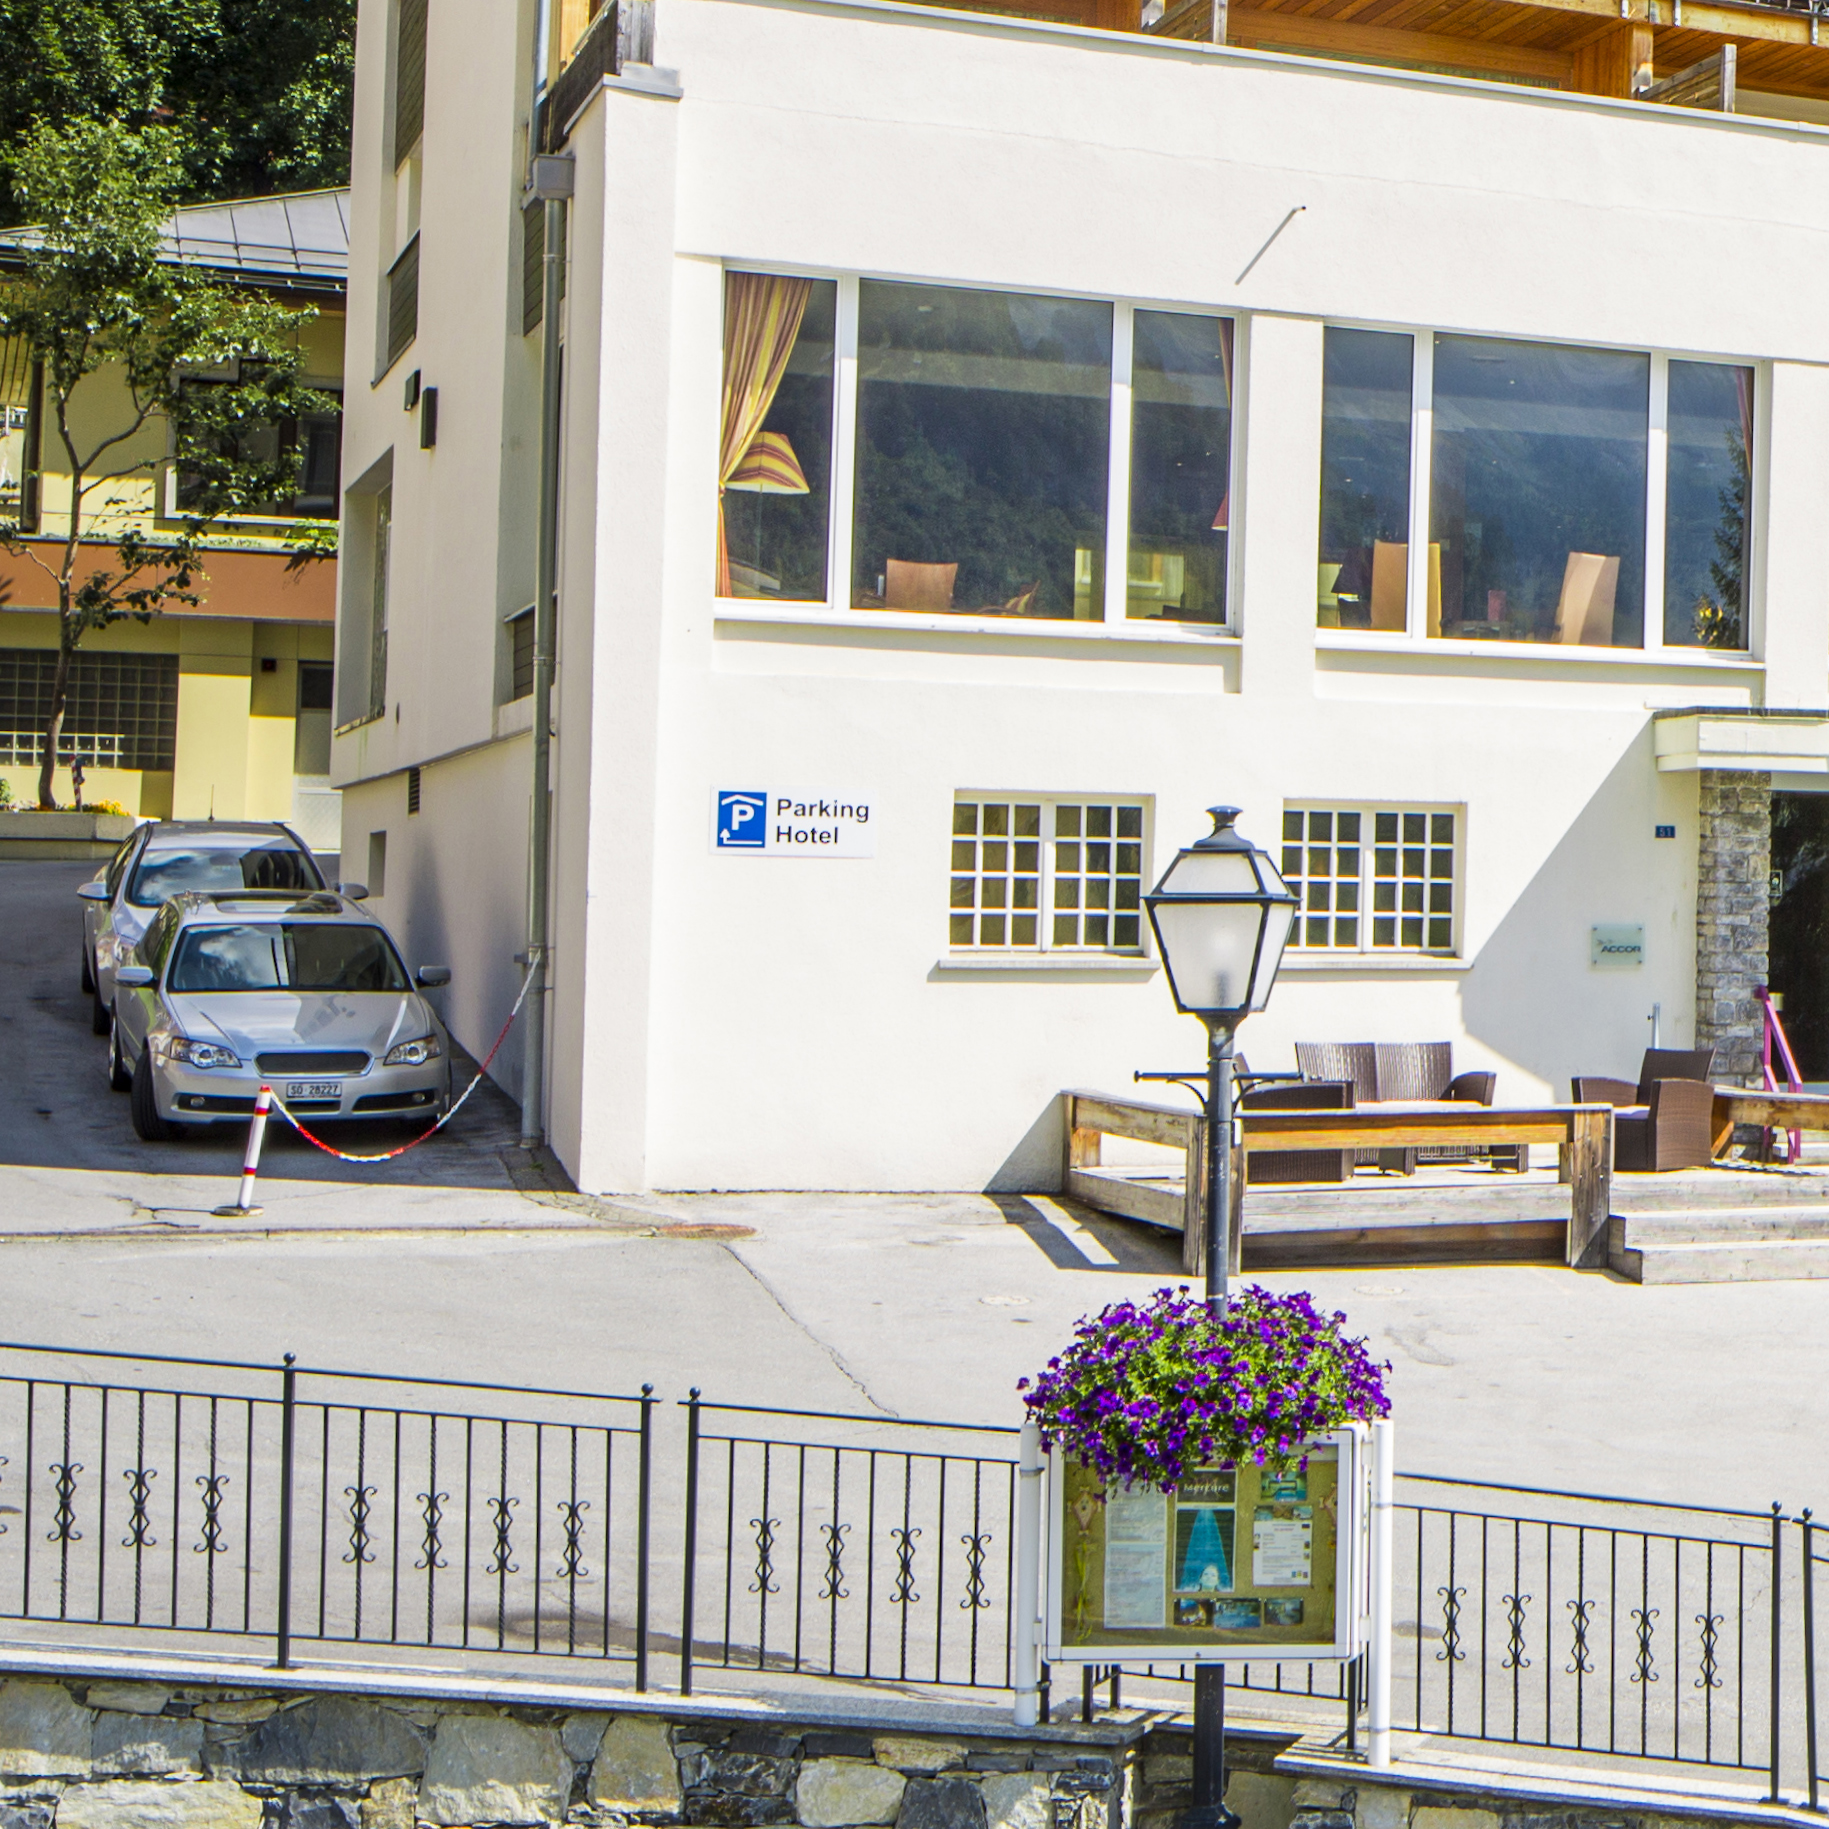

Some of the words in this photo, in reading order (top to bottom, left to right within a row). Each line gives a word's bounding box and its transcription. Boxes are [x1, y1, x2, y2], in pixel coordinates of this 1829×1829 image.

[731, 803, 755, 831] P
[777, 798, 869, 823] Parking
[775, 825, 839, 844] Hotel
[1601, 945, 1641, 953] ACCOR
